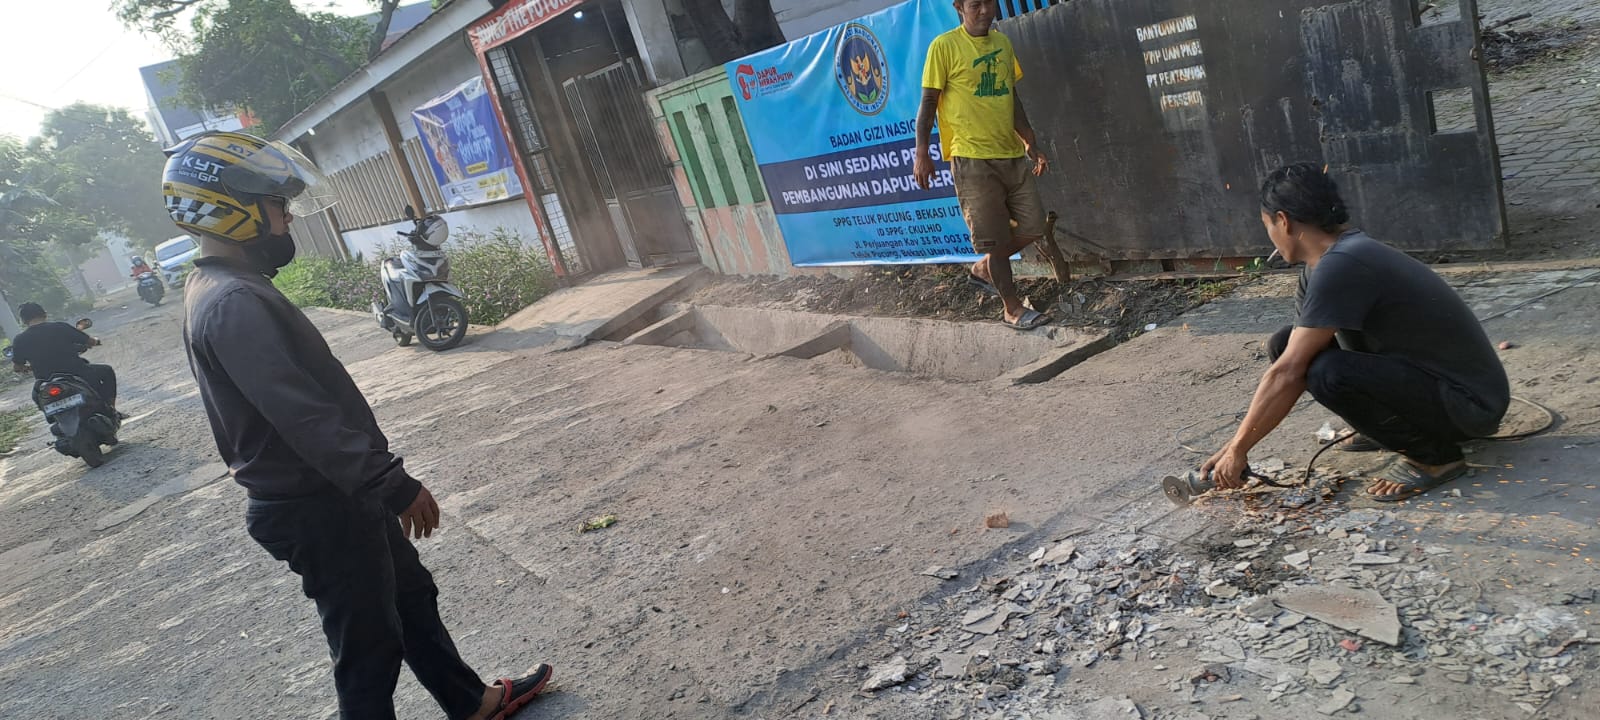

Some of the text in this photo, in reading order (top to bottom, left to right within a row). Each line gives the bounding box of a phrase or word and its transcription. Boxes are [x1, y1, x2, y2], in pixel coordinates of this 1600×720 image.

[830, 133, 862, 148] BADAN
[863, 125, 884, 142] GIZI
[182, 156, 225, 176] KYT
[804, 165, 818, 181] DI
[820, 161, 844, 179] SINI
[845, 152, 900, 175] SEDANG
[198, 171, 219, 182] GP
[782, 180, 871, 206] PEMBANGUNAN
[871, 174, 920, 197] DAPUR
[833, 214, 852, 228] SPPG
[852, 213, 877, 227] TELUK
[916, 206, 947, 221] BEKASI
[947, 204, 961, 217] UT
[877, 227, 885, 237] ID
[886, 226, 904, 236] SPPG
[863, 238, 904, 250] Perjuangan
[904, 237, 919, 247] Kav
[920, 236, 931, 245] 33
[932, 235, 943, 245] Rt
[943, 234, 961, 244] 003
[953, 245, 975, 256] Kota
